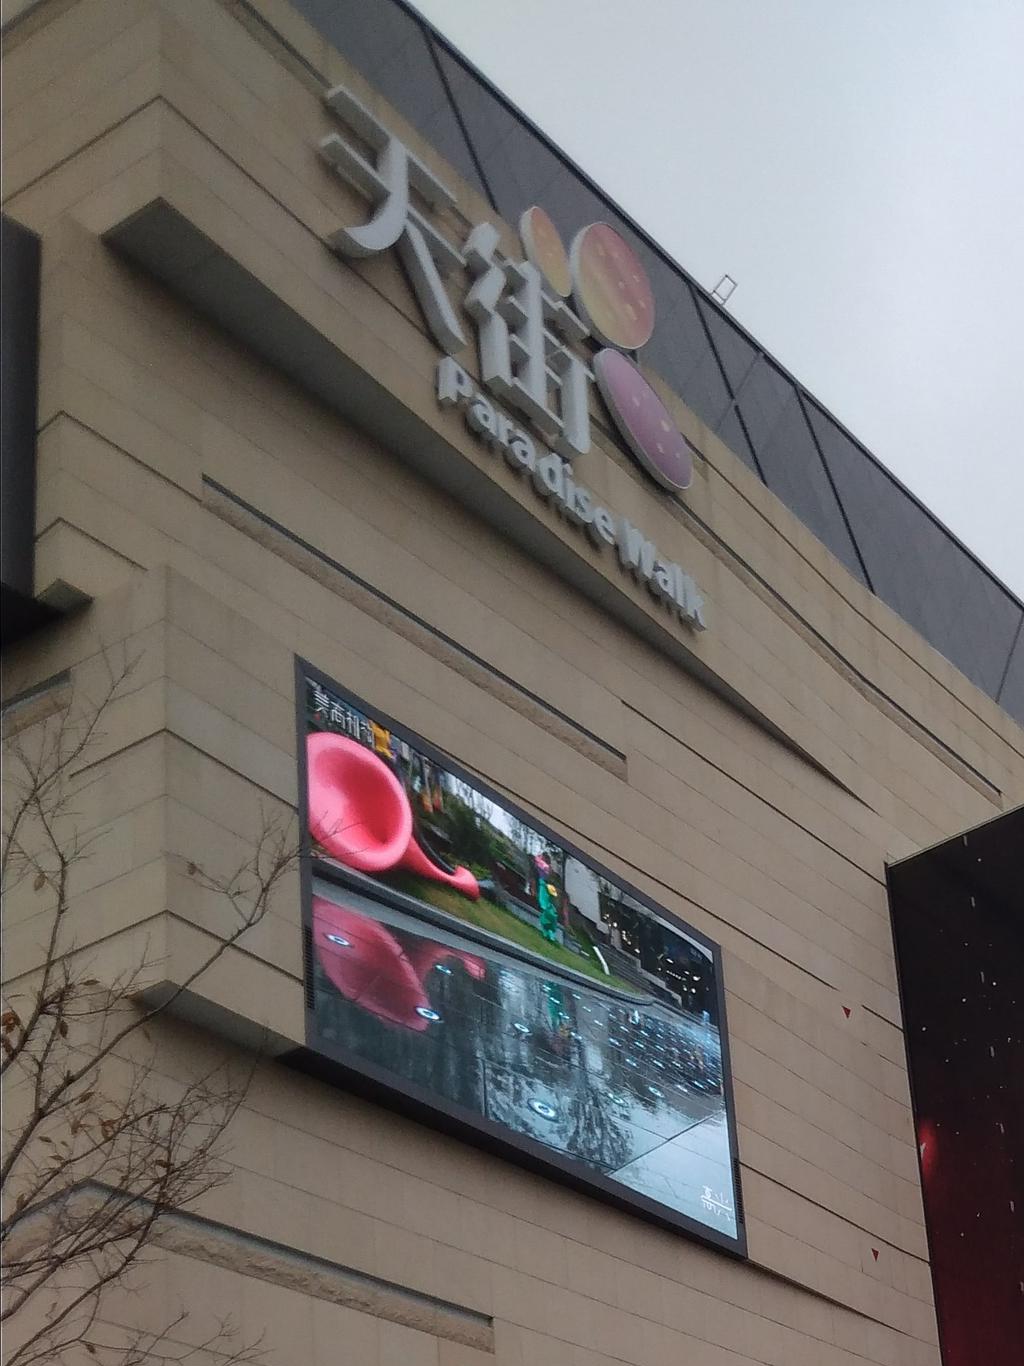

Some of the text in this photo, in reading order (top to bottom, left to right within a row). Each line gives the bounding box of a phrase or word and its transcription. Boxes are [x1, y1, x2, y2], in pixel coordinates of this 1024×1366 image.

[320, 84, 590, 456] 天街
[437, 357, 707, 632] Paradise Walk
